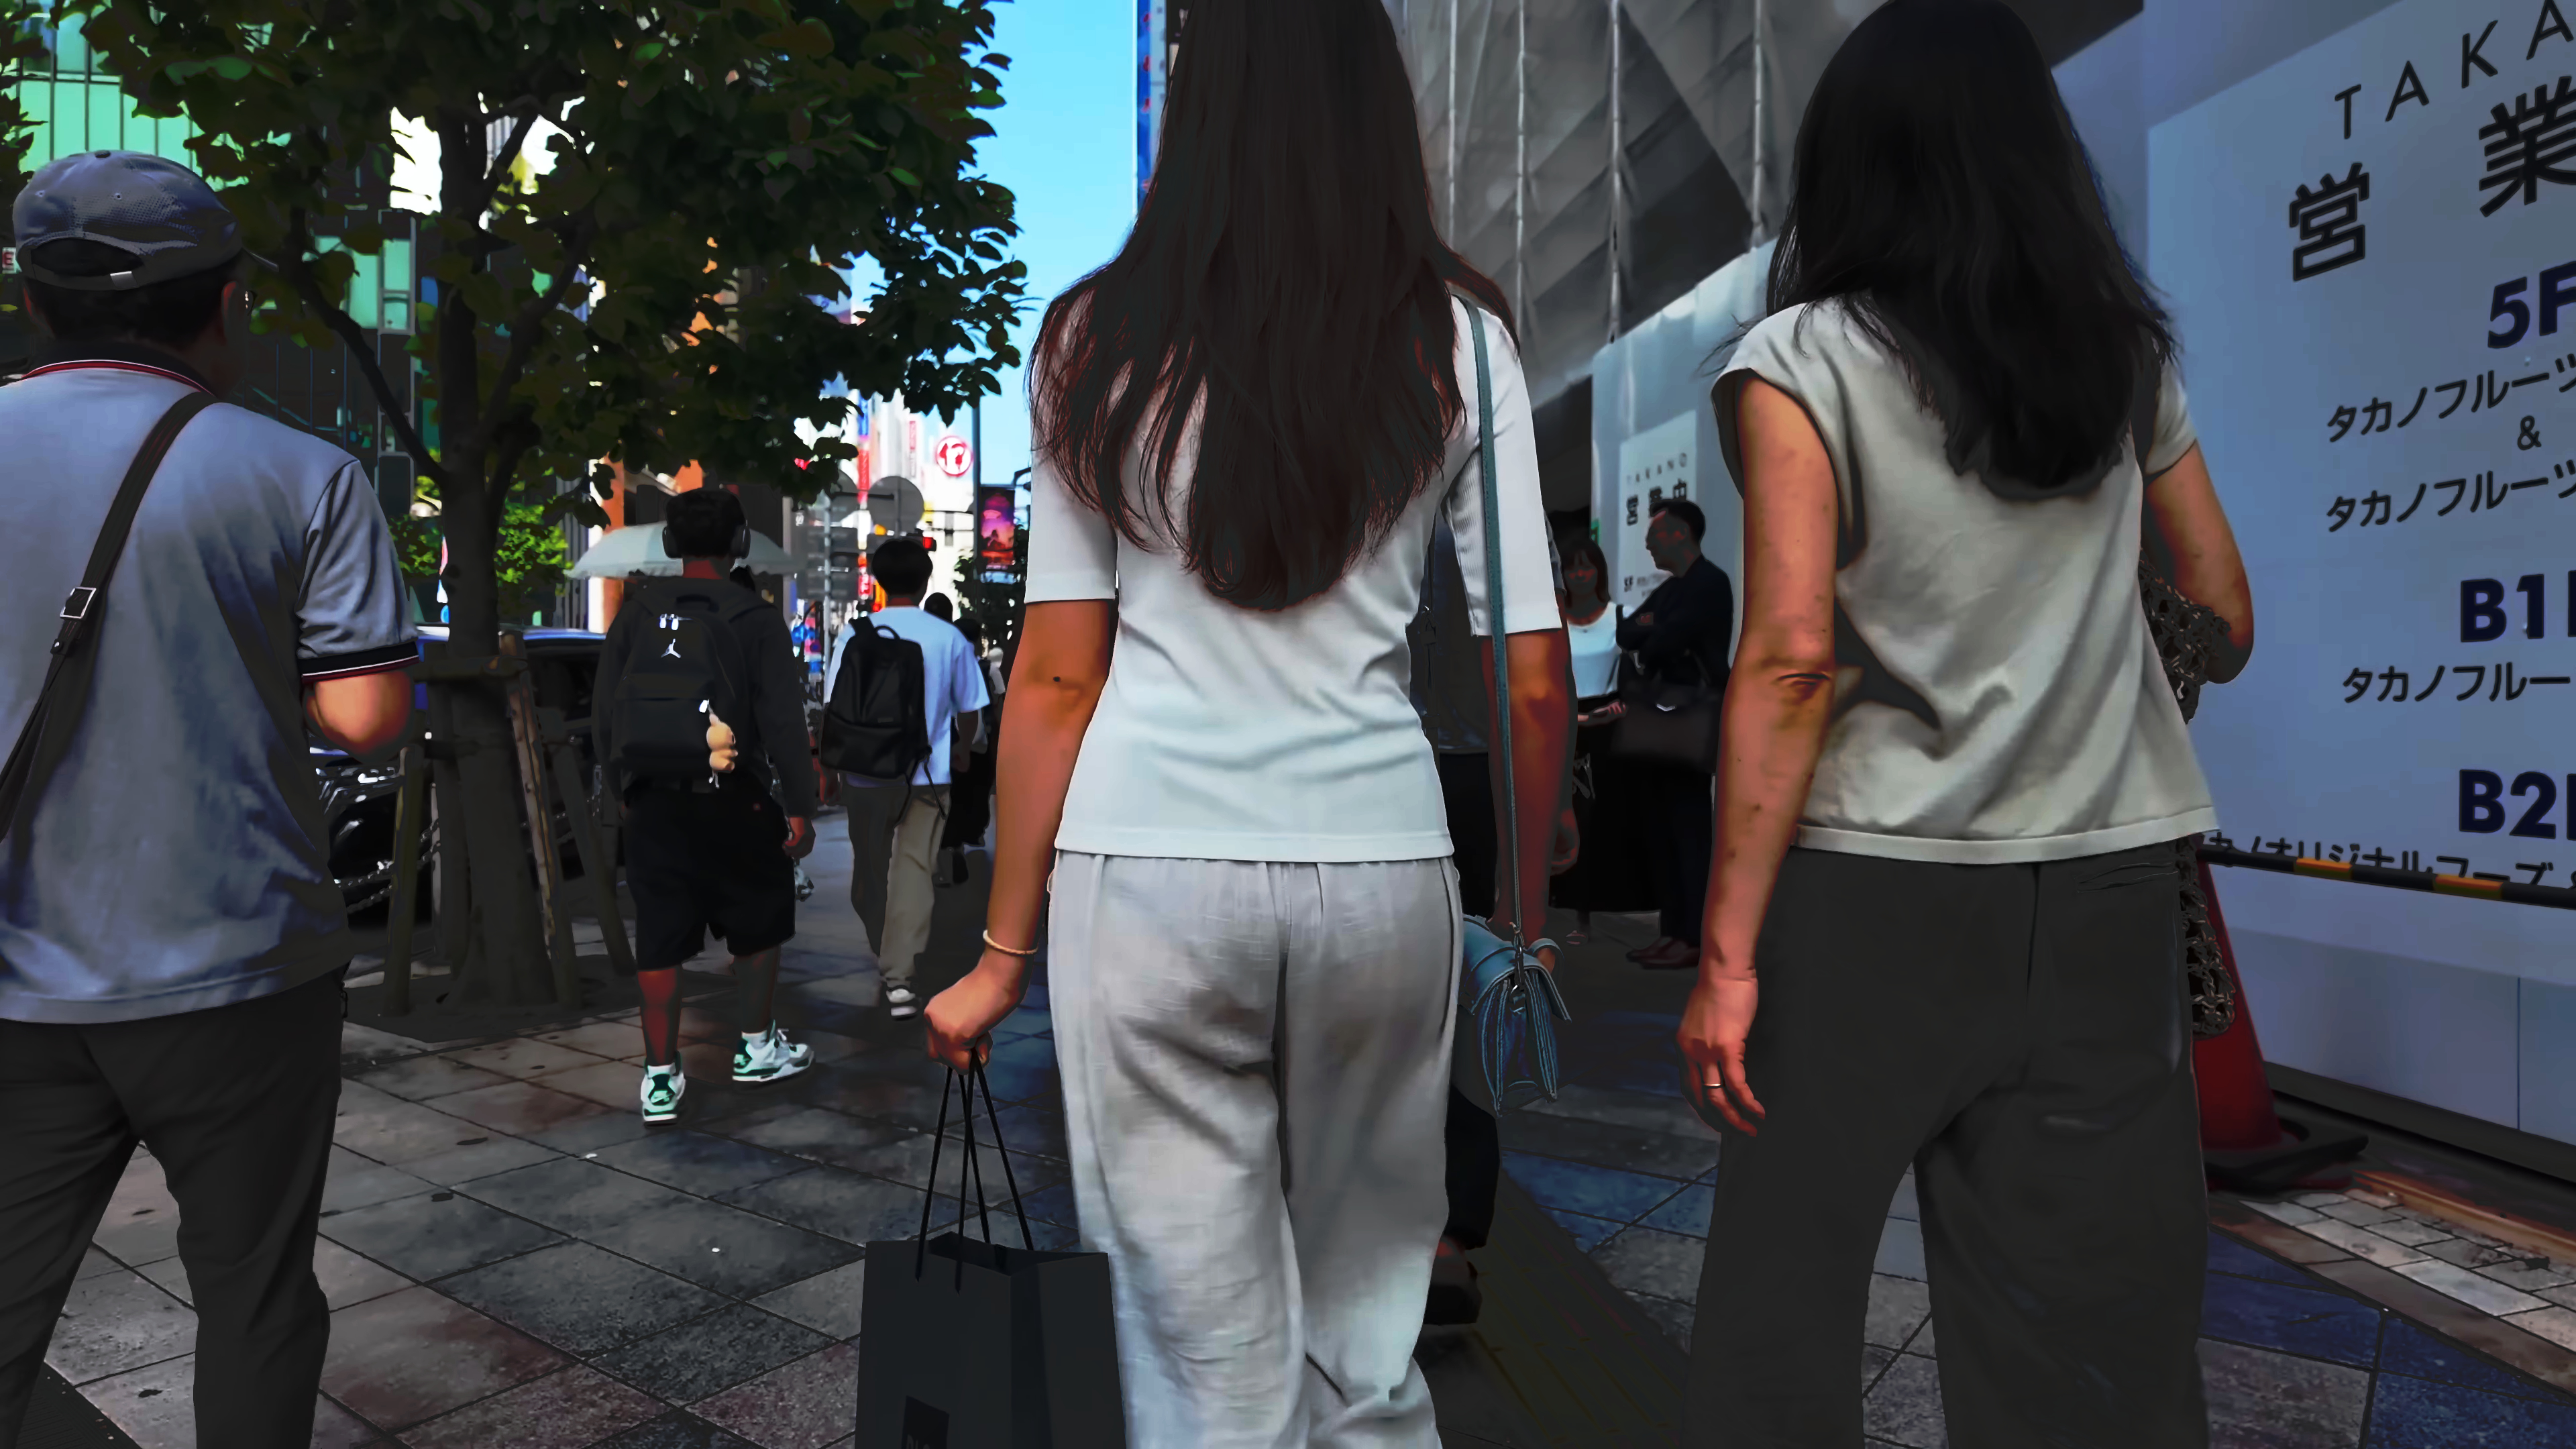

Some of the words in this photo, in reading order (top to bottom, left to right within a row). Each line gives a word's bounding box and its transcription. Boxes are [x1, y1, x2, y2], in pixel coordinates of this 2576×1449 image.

[2334, 0, 2574, 140] TAKA
[2290, 76, 2576, 282] 営業
[2488, 262, 2576, 348] 5F
[2518, 416, 2541, 450] &
[2460, 570, 2576, 642] B1
[2343, 661, 2571, 703] タカノフルー
[2459, 769, 2576, 840] B2
